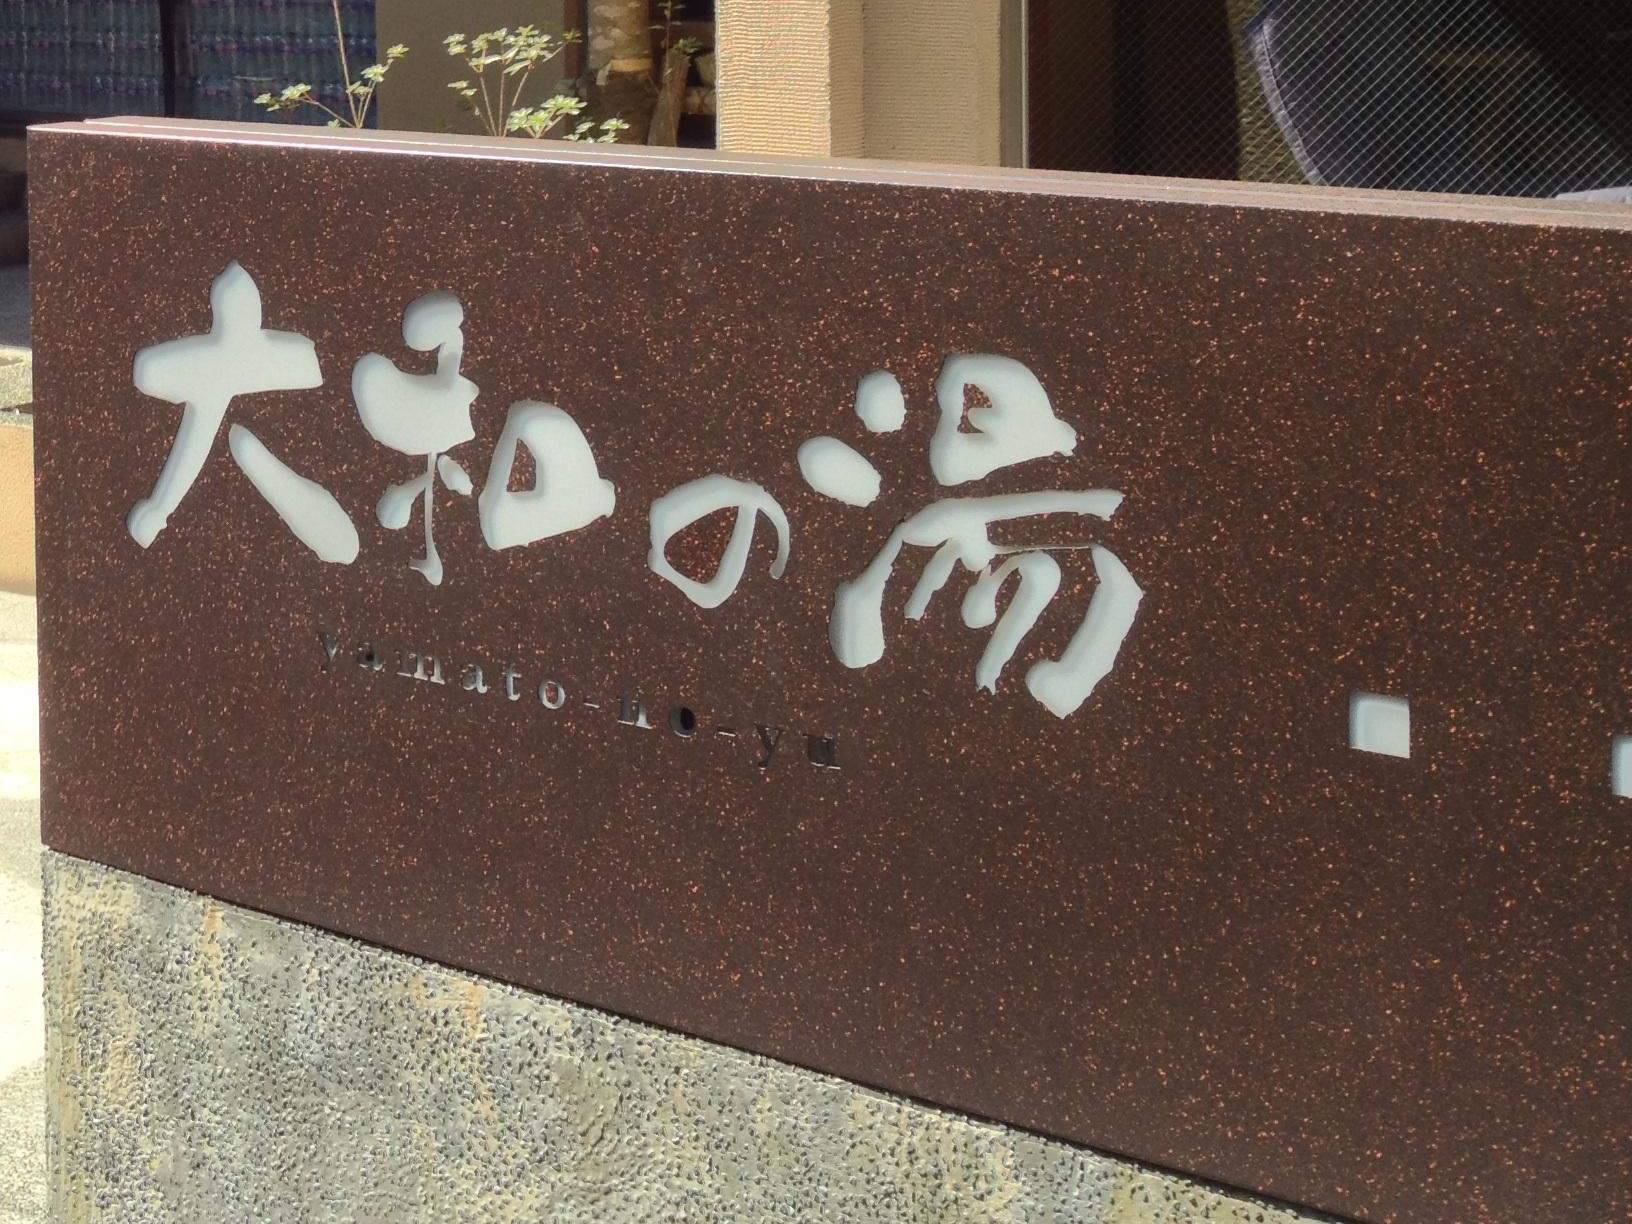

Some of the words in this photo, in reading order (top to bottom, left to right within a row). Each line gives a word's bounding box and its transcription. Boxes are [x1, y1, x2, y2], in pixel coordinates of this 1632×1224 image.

[126, 260, 1145, 718] 大和の湯
[318, 629, 841, 771] yamato-no-yu
